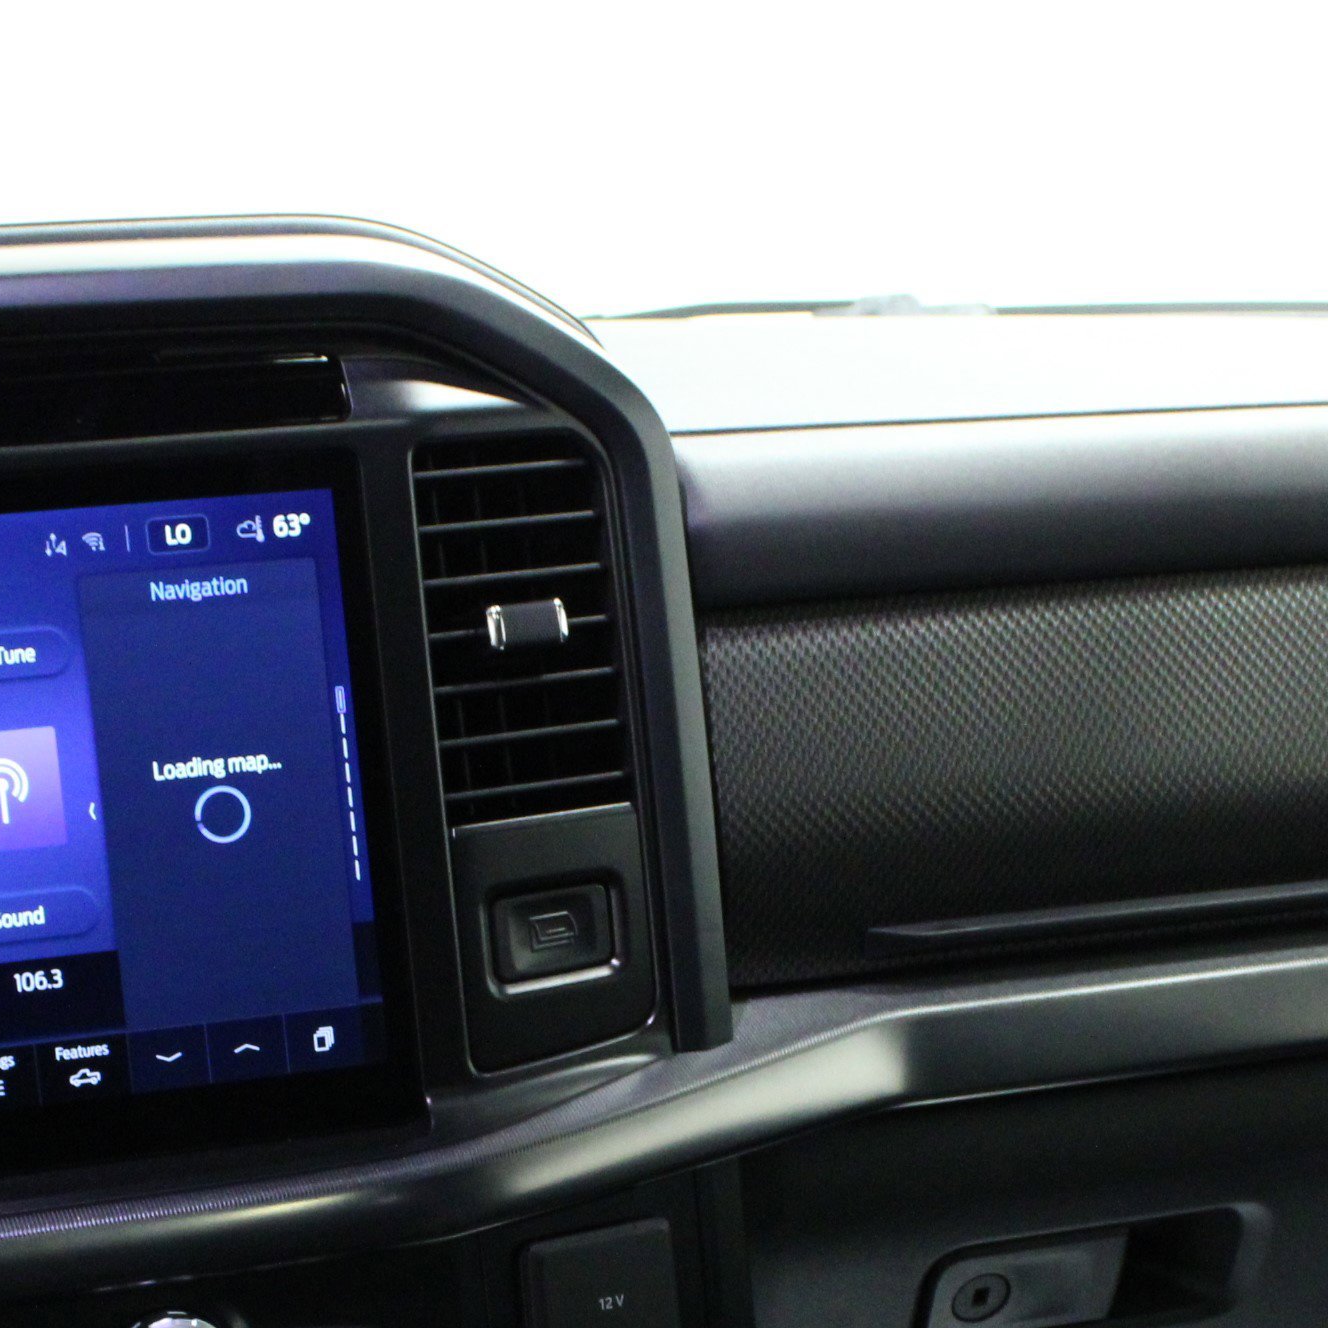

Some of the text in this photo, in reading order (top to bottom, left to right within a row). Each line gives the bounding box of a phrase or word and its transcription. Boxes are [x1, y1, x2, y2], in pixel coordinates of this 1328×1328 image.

[164, 524, 192, 546] LO
[150, 575, 248, 603] Navigation
[153, 752, 282, 782] Loading map...
[13, 969, 63, 993] 106.3
[55, 1042, 109, 1062] Features
[598, 1297, 614, 1311] 12
